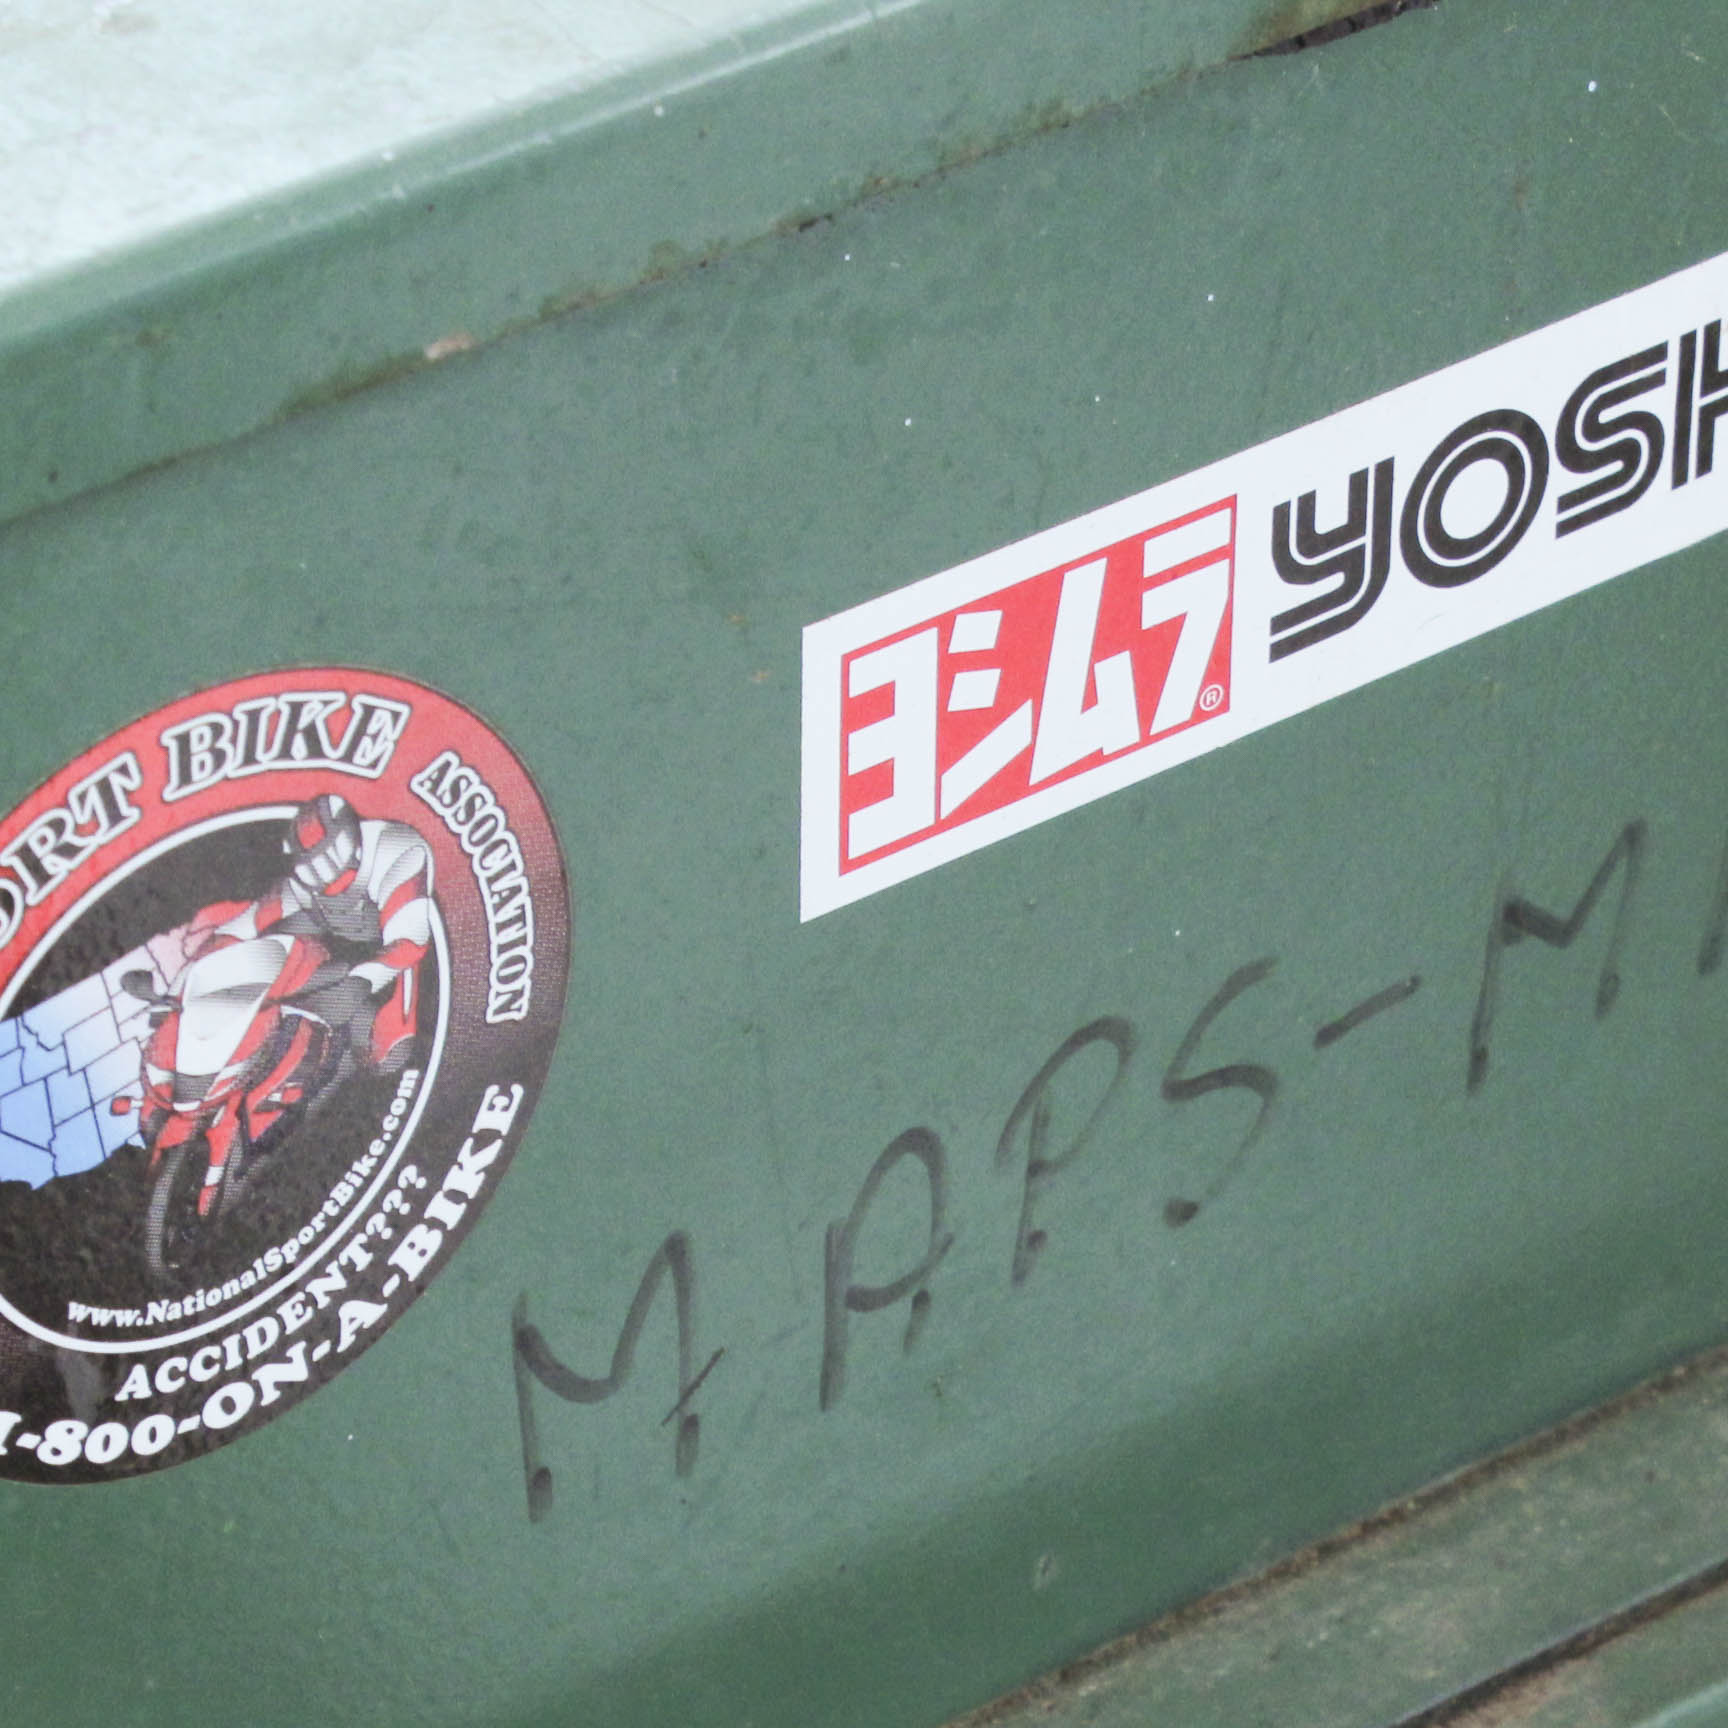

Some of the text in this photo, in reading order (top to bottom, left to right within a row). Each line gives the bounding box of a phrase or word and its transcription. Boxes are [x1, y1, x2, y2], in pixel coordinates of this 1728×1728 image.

[846, 505, 1233, 862] ヨシムラ
[161, 690, 411, 802] BIKE
[410, 751, 536, 1024] ASSOCIATION
[66, 1067, 420, 1331] www.NationalSportBike.com
[114, 1163, 427, 1402] ACCIDENT???
